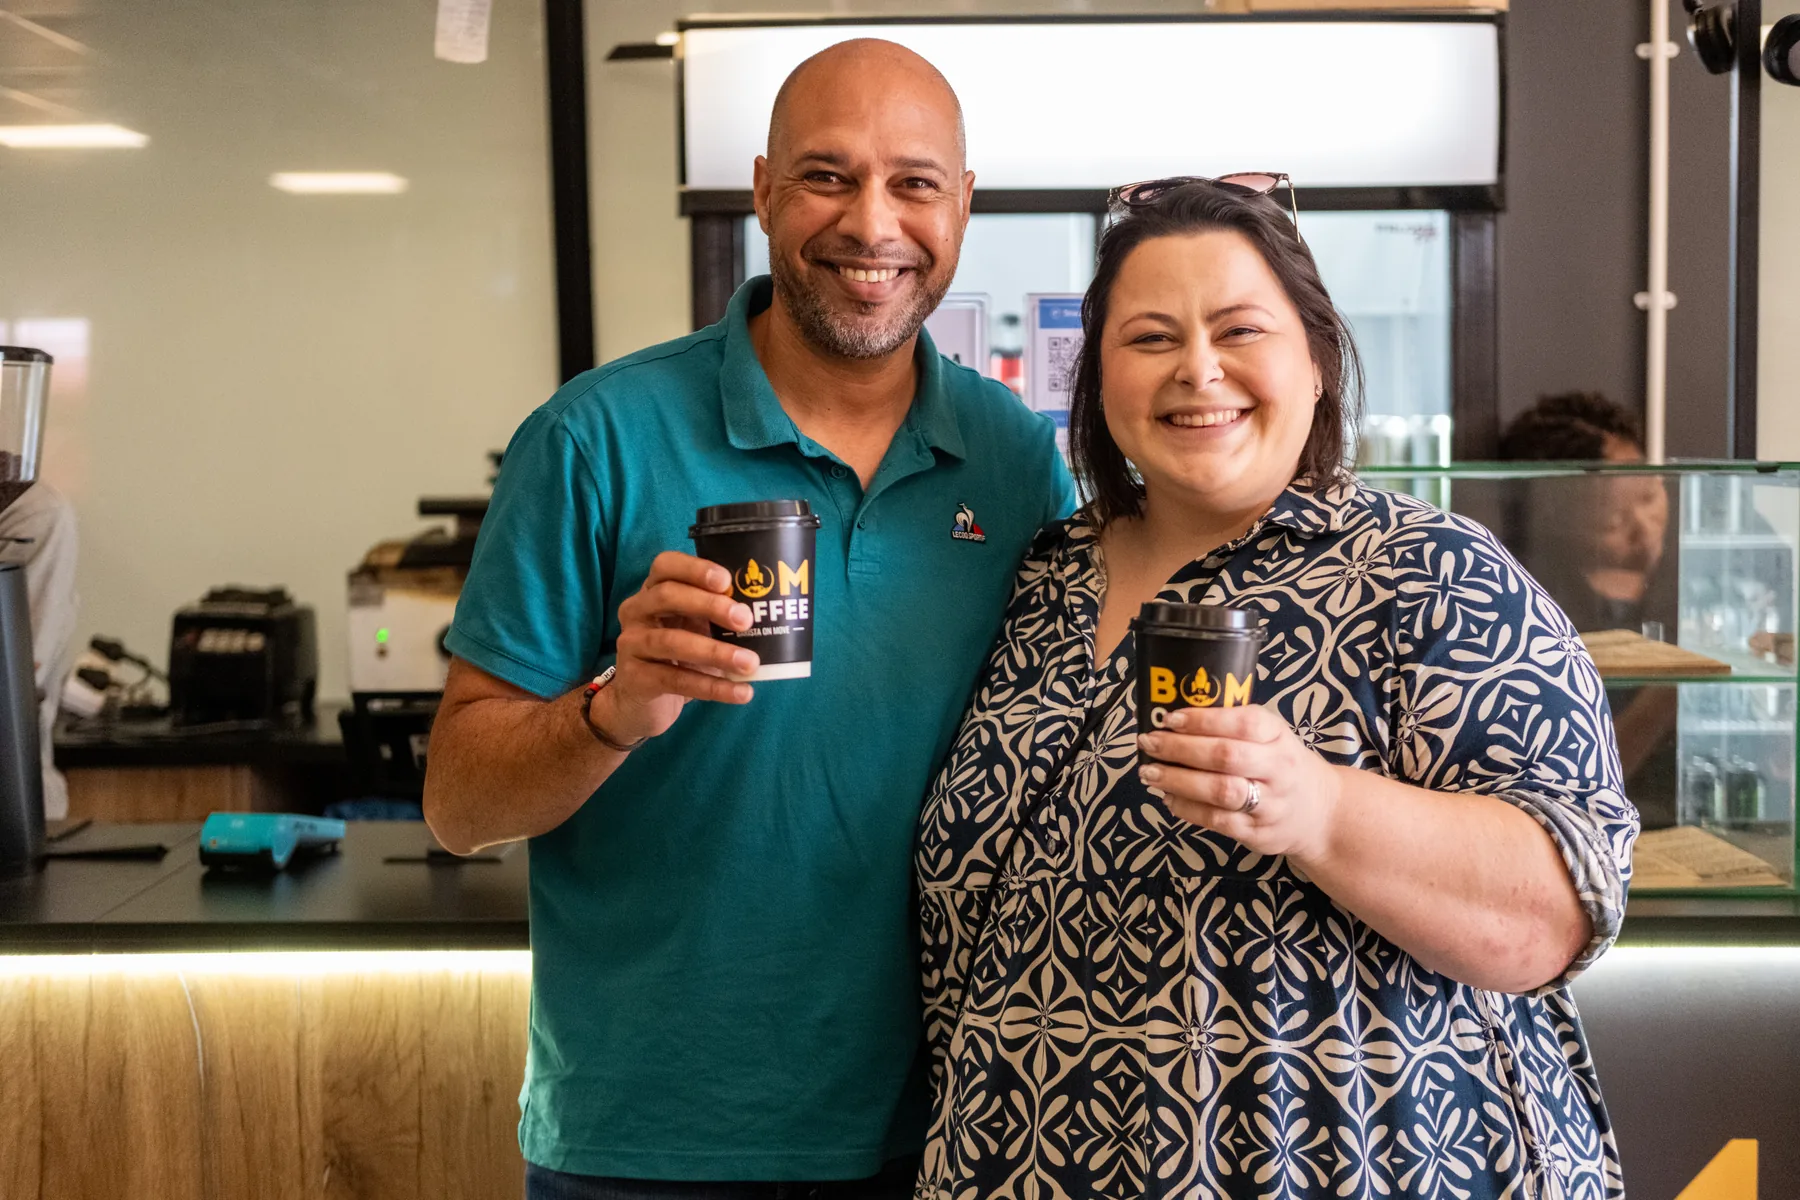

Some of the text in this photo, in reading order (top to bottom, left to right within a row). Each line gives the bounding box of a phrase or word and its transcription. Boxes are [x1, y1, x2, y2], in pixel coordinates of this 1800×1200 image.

[752, 598, 808, 622] FFEE
[762, 626, 773, 636] ON
[773, 625, 790, 635] MOVE
